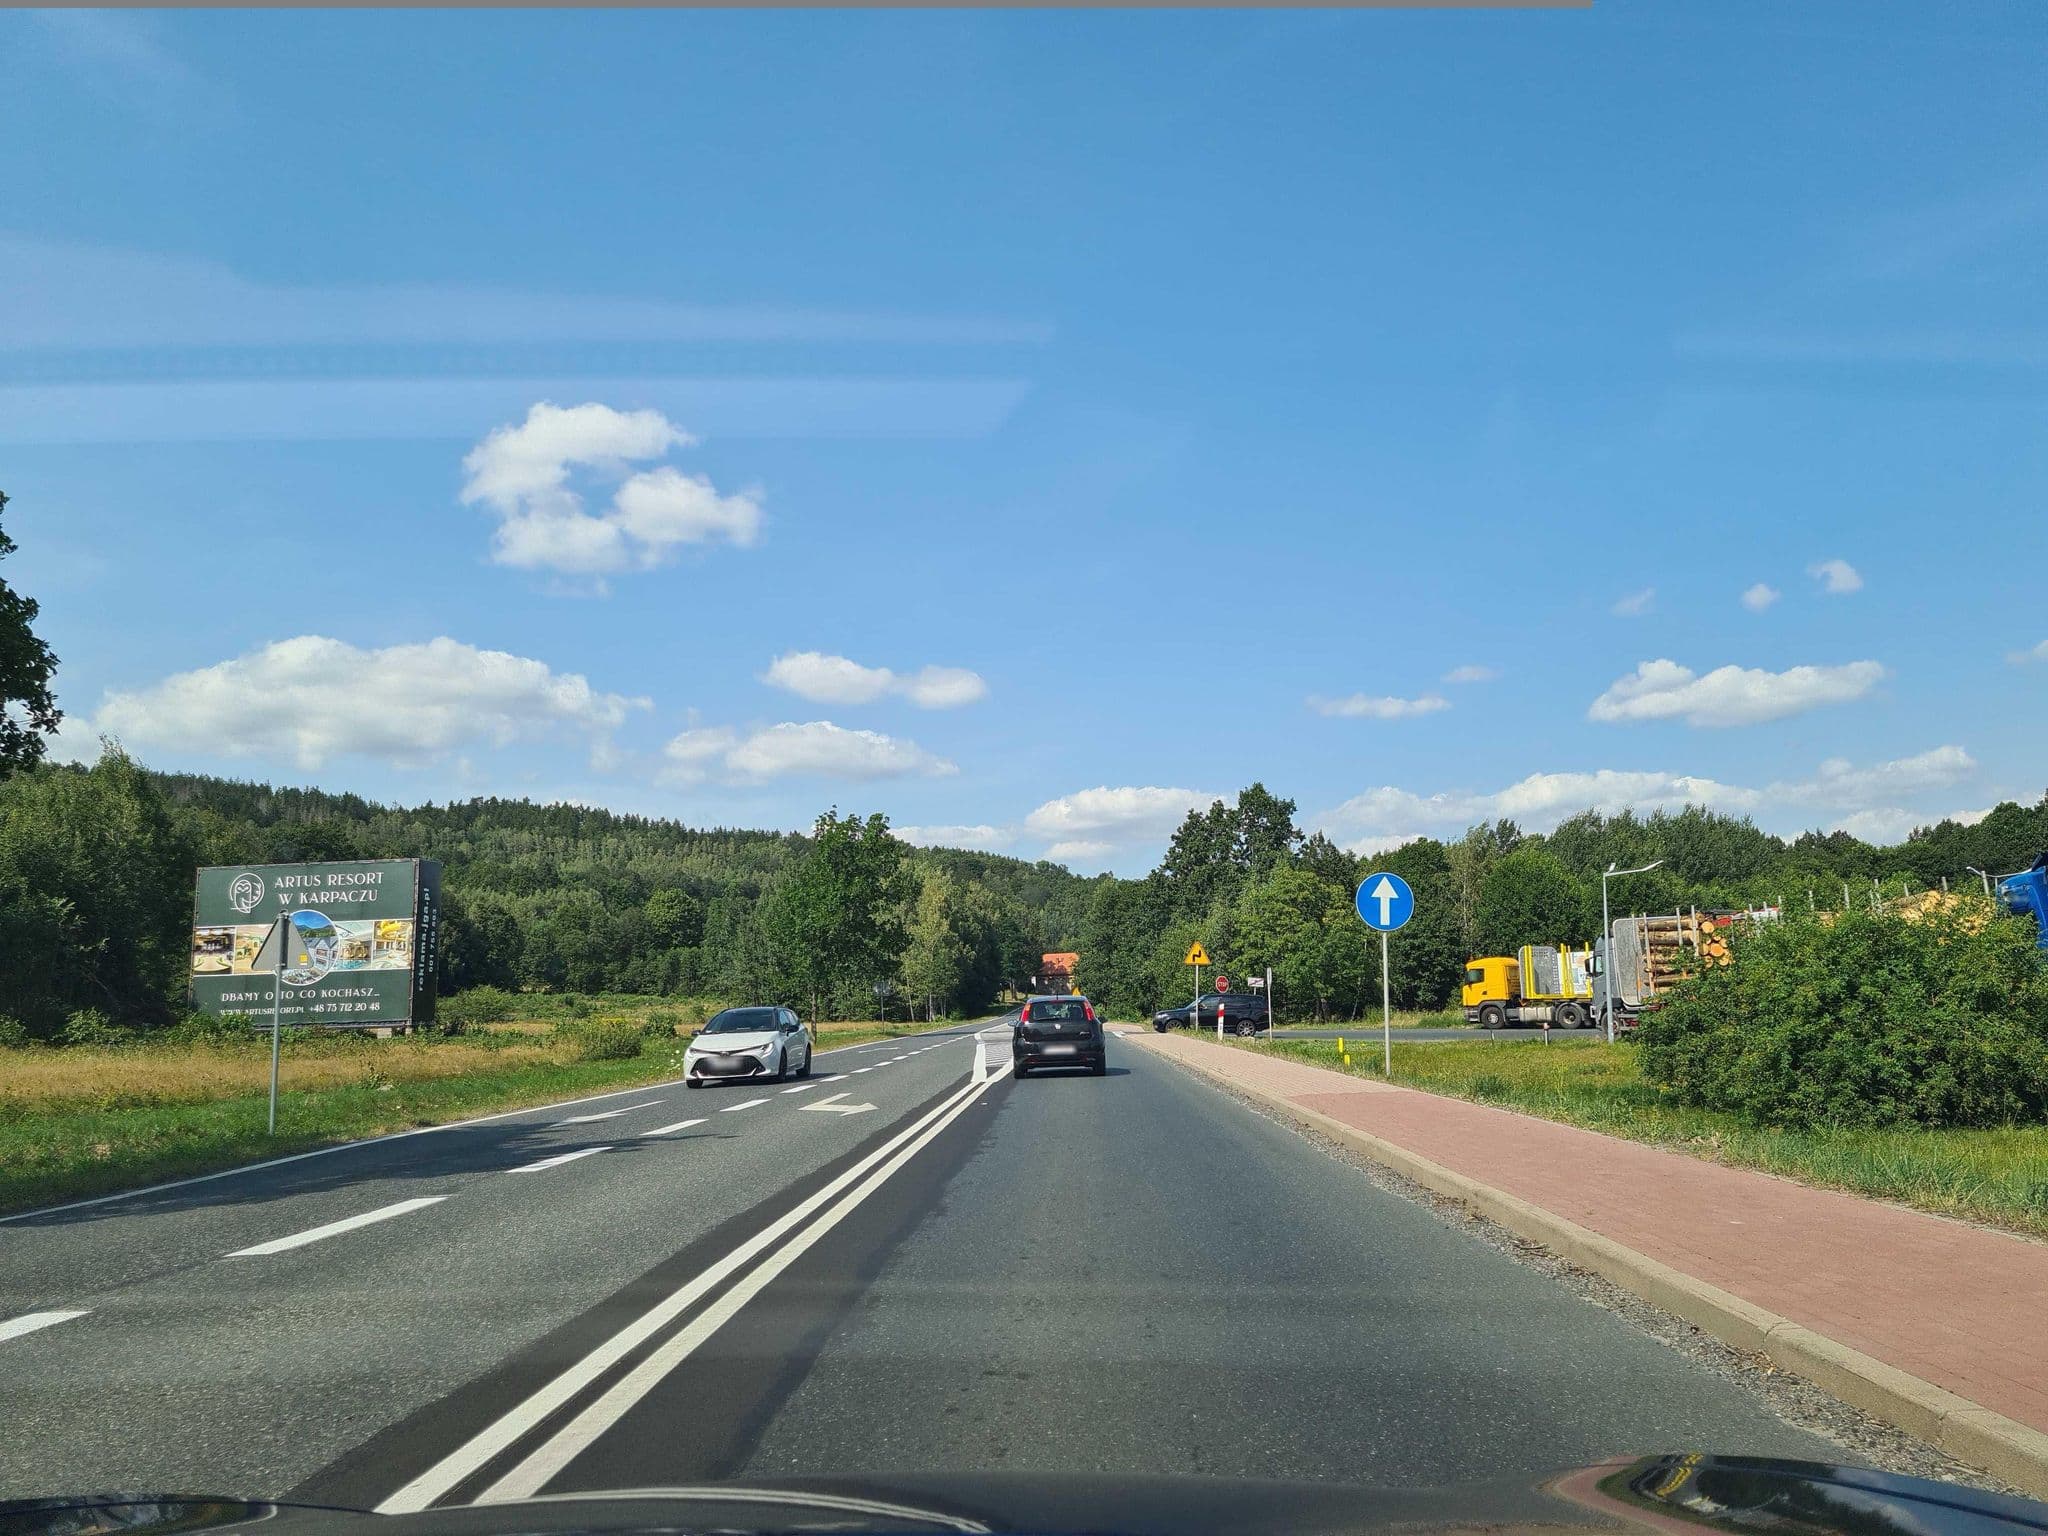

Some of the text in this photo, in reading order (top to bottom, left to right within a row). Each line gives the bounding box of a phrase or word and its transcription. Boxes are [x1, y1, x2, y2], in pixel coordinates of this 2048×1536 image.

[274, 871, 384, 888] ARTUS RESORT
[278, 889, 378, 905] W KARPACZU
[222, 992, 260, 1002] DBAMY
[265, 991, 274, 1001] O
[300, 989, 316, 999] CO
[309, 1004, 325, 1013] +48
[327, 1003, 337, 1012] 75
[340, 1003, 352, 1012] 712
[354, 1002, 367, 1011] 20
[369, 1002, 380, 1011] 48
